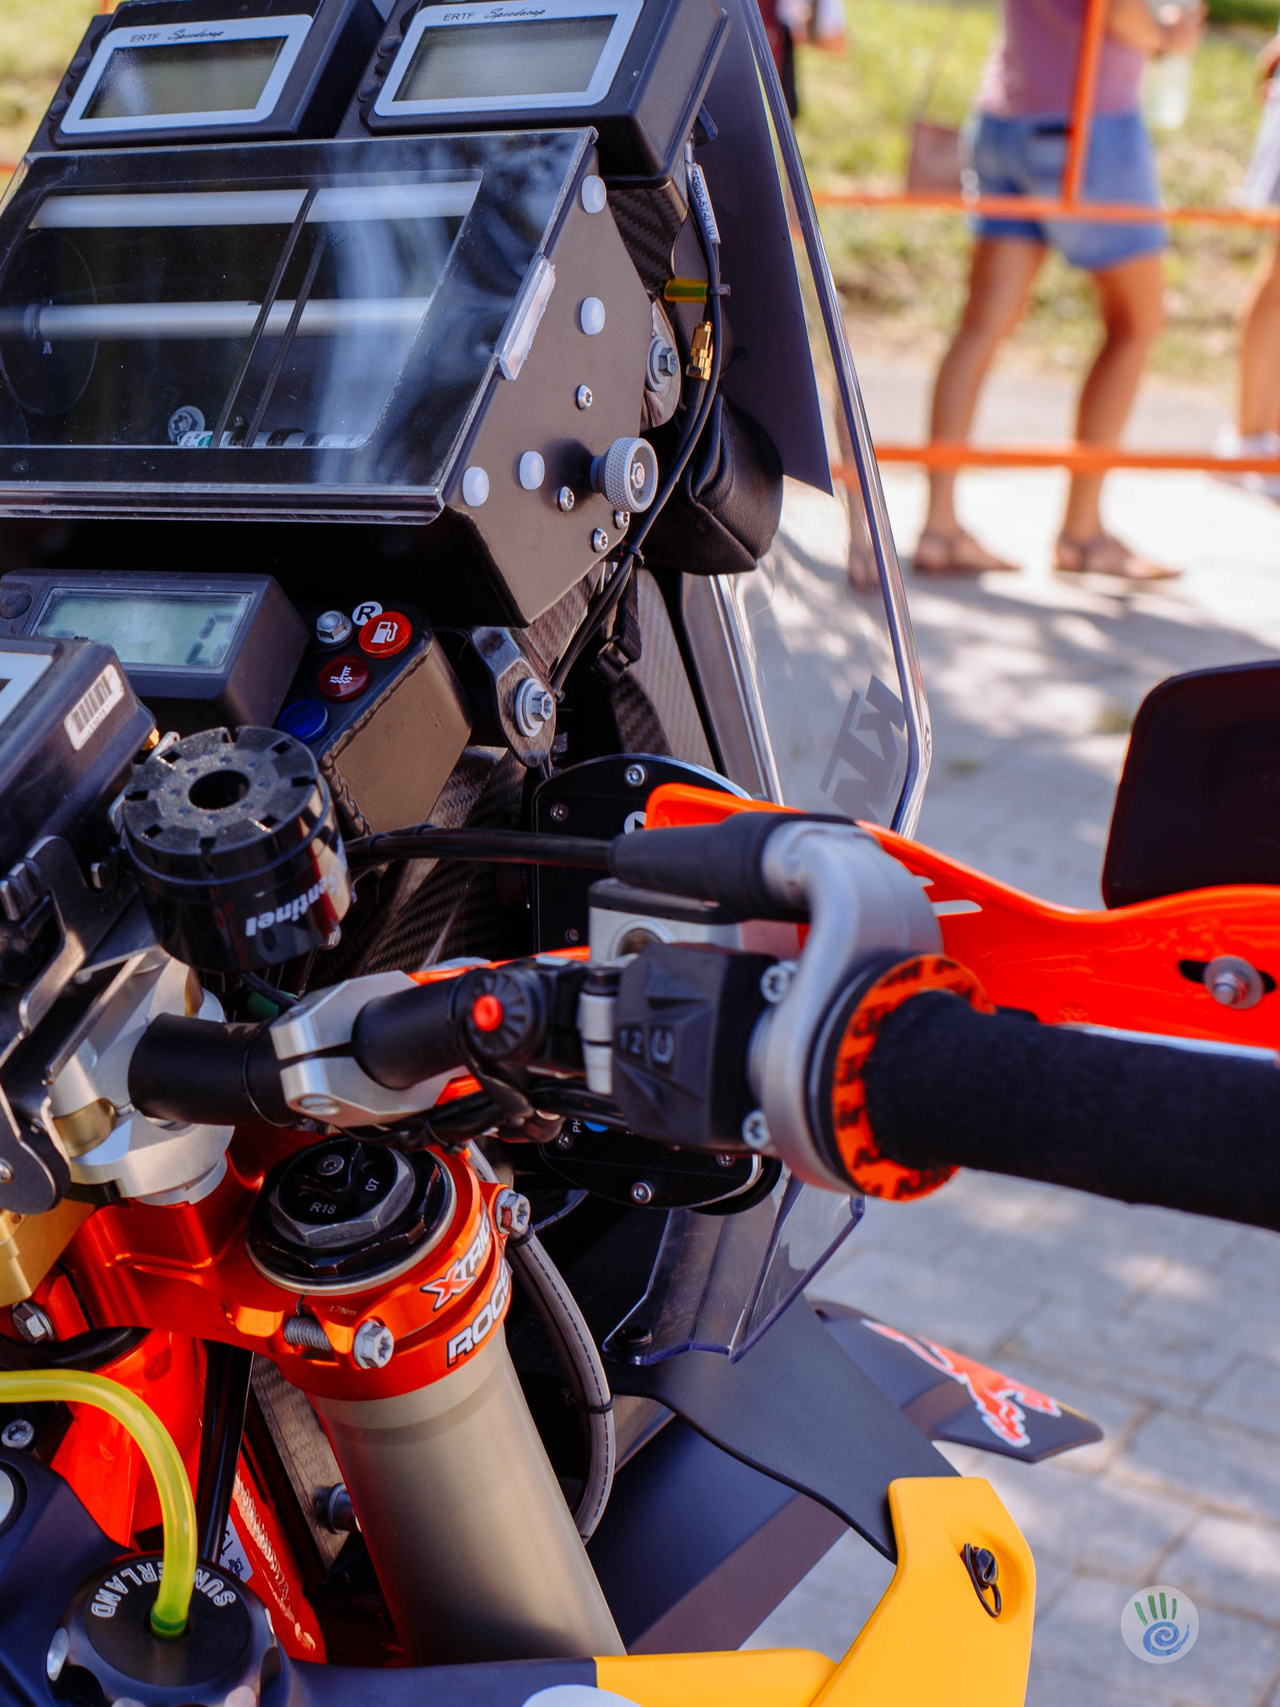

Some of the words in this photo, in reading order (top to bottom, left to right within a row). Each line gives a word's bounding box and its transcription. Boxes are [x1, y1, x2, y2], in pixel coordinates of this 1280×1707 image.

[443, 12, 476, 21] ERTF
[130, 33, 160, 42] ERTF
[356, 605, 376, 622] R
[819, 673, 906, 824] KTM
[245, 867, 343, 937] Sentinel
[365, 1178, 380, 1192] 07
[309, 1201, 337, 1215] R18
[328, 1304, 357, 1317] 17Nm
